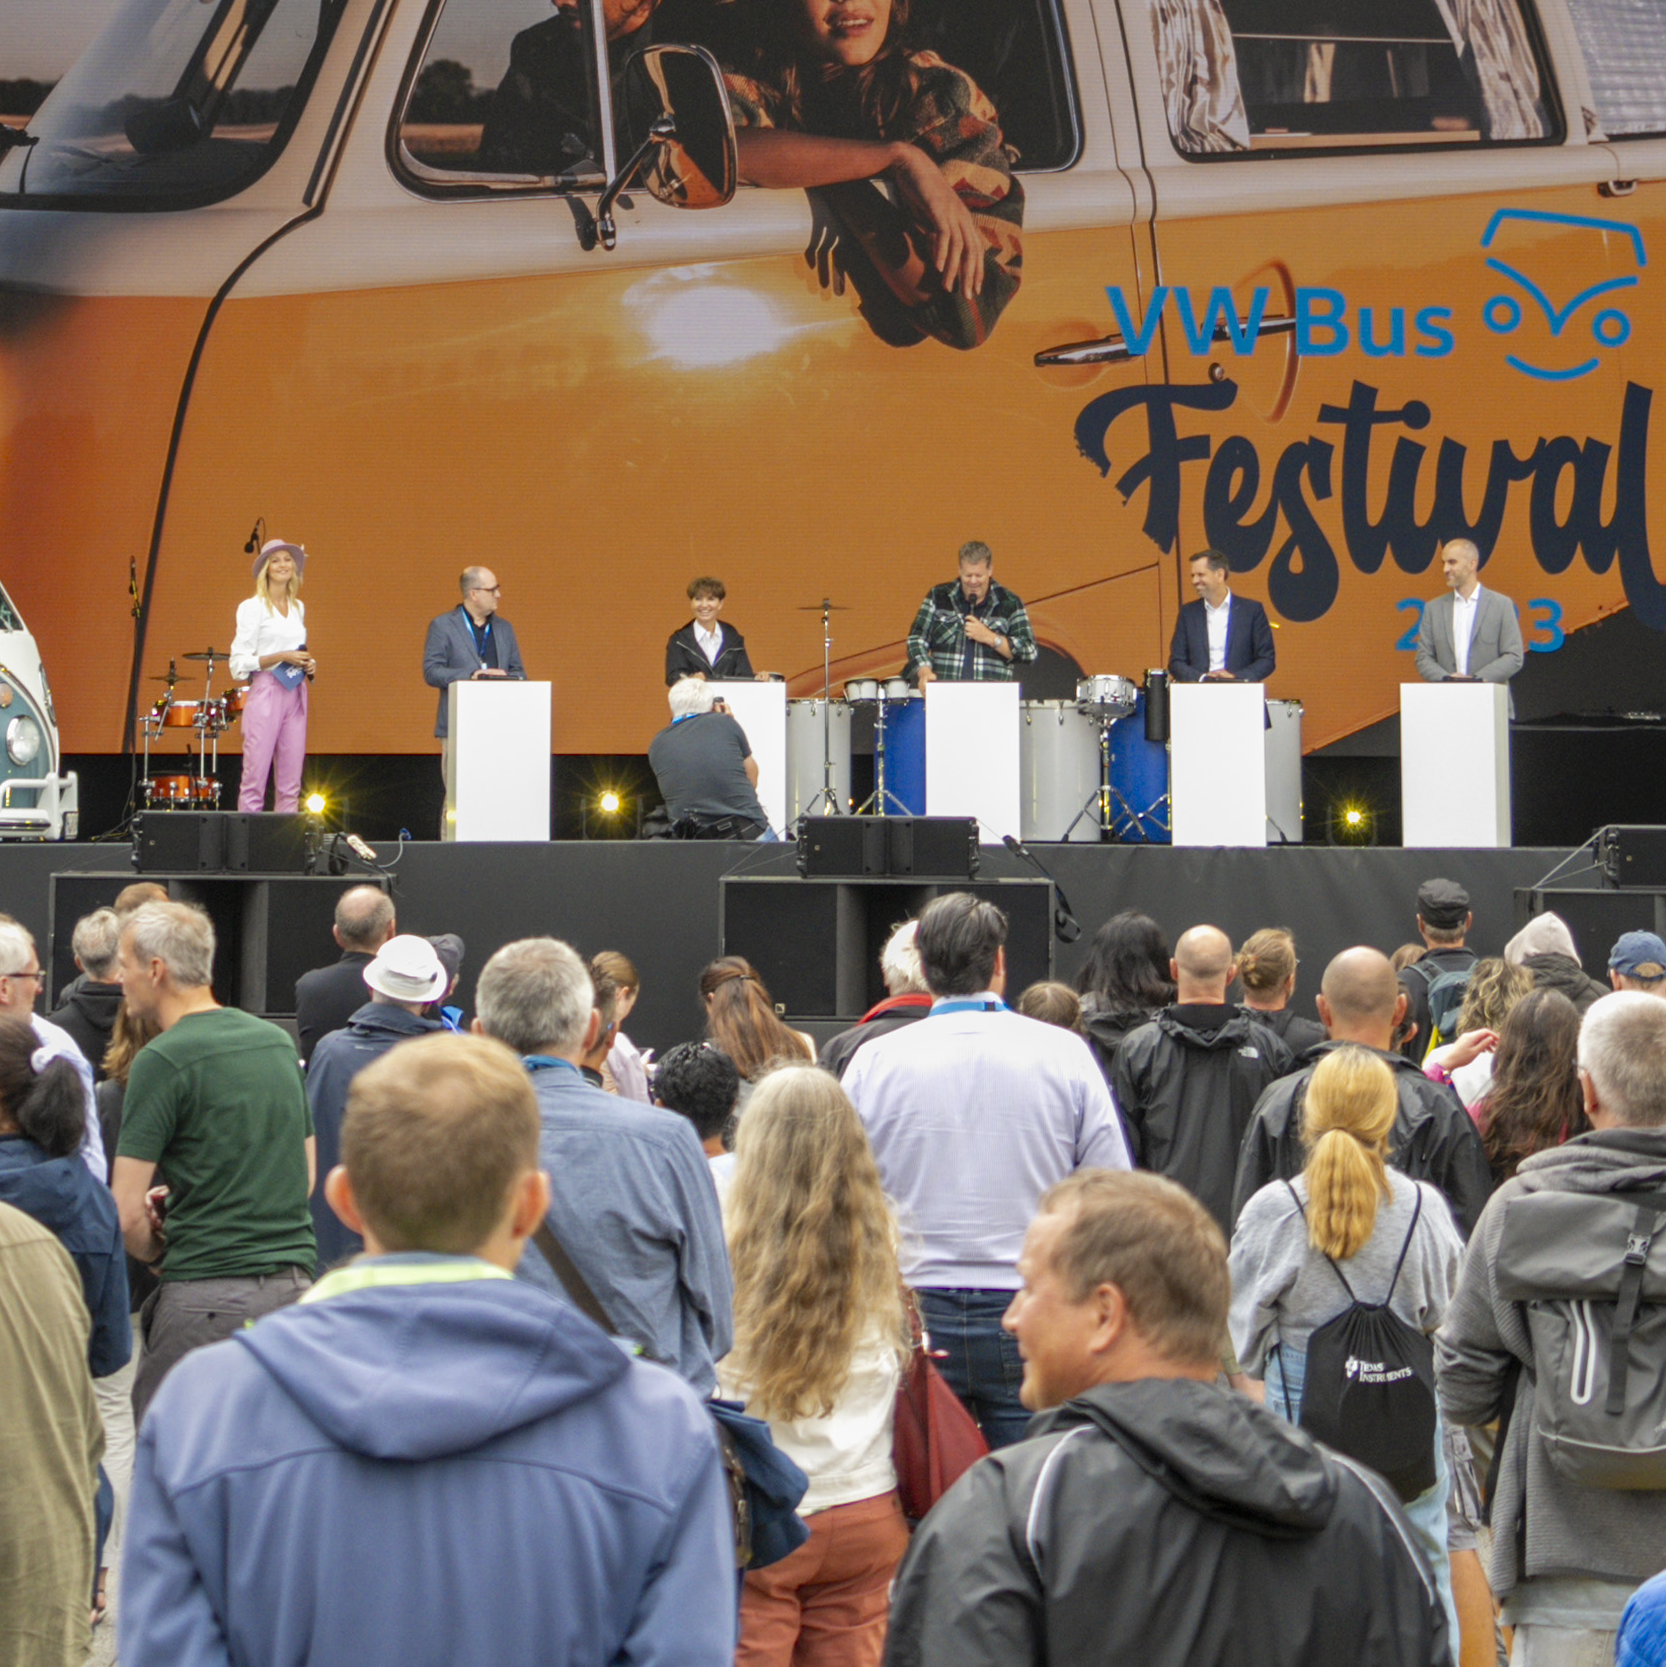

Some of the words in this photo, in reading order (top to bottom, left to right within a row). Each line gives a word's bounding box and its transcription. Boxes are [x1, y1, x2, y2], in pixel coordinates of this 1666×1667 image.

[1105, 285, 1269, 357] VW
[1295, 287, 1455, 358] Bus
[1395, 597, 1566, 654] 23
[1359, 1360, 1384, 1372] TEXAS
